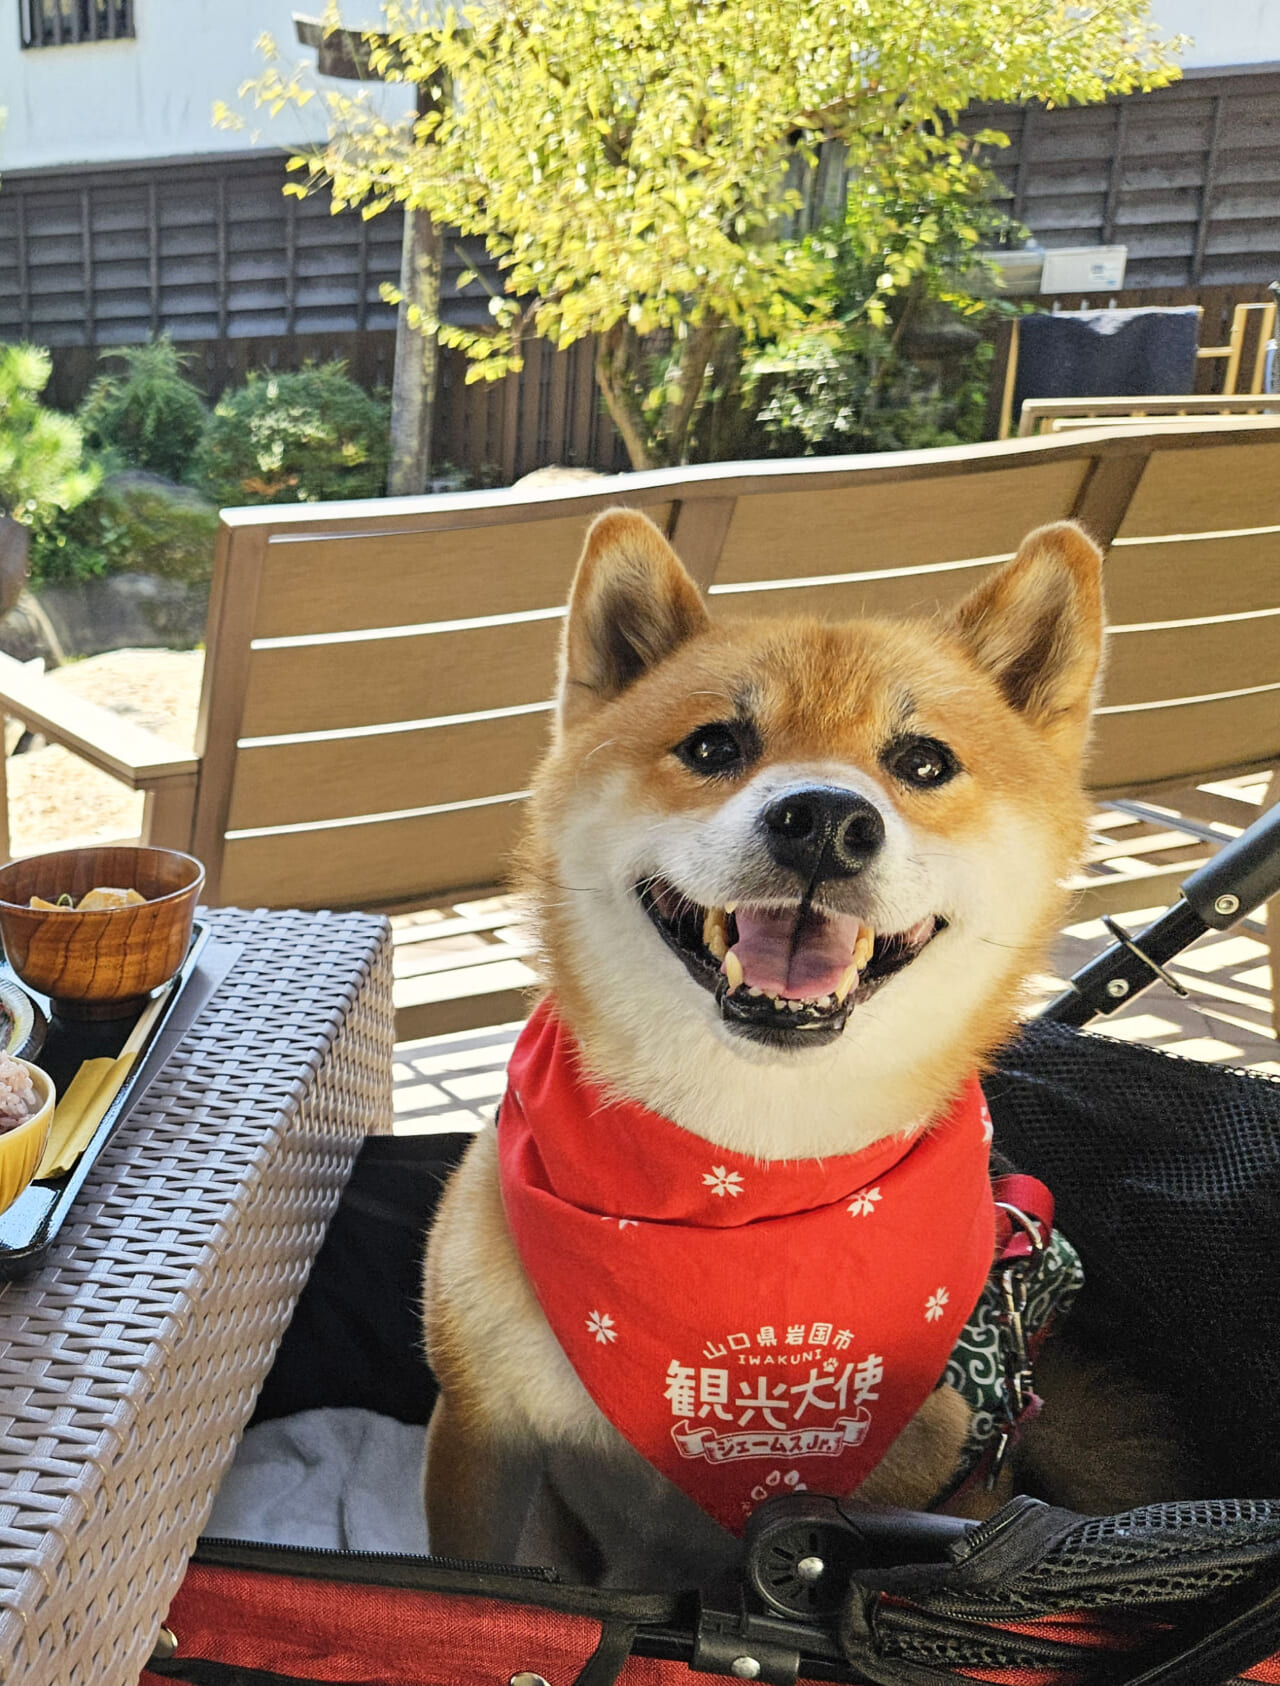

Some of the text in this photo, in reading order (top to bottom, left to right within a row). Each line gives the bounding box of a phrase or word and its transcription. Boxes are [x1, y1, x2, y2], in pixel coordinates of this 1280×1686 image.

[702, 1322, 855, 1360] 山口県岩国市
[738, 1348, 822, 1366] IWAKUNI
